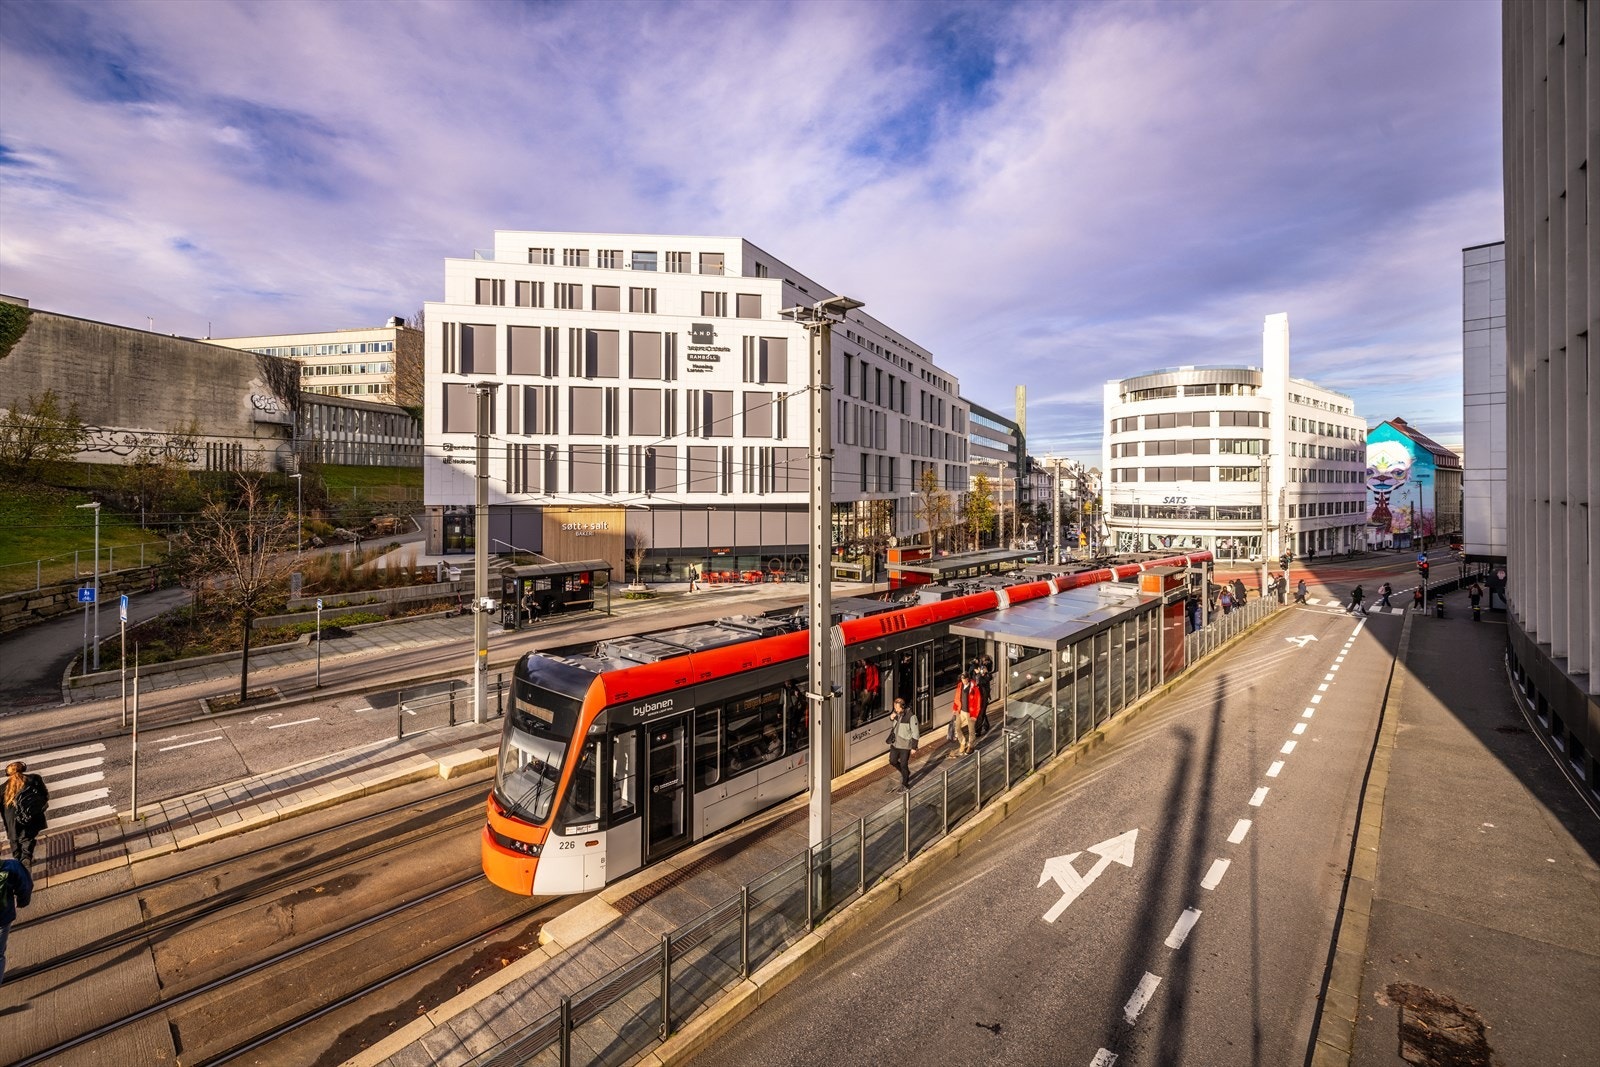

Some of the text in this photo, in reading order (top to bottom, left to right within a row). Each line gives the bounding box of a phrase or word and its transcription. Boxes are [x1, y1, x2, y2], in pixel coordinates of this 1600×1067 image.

[1162, 496, 1188, 504] SATS
[561, 522, 582, 530] søtt
[590, 521, 608, 530] salt
[632, 698, 674, 716] bybanen
[852, 730, 868, 742] skyss
[559, 840, 576, 850] 226
